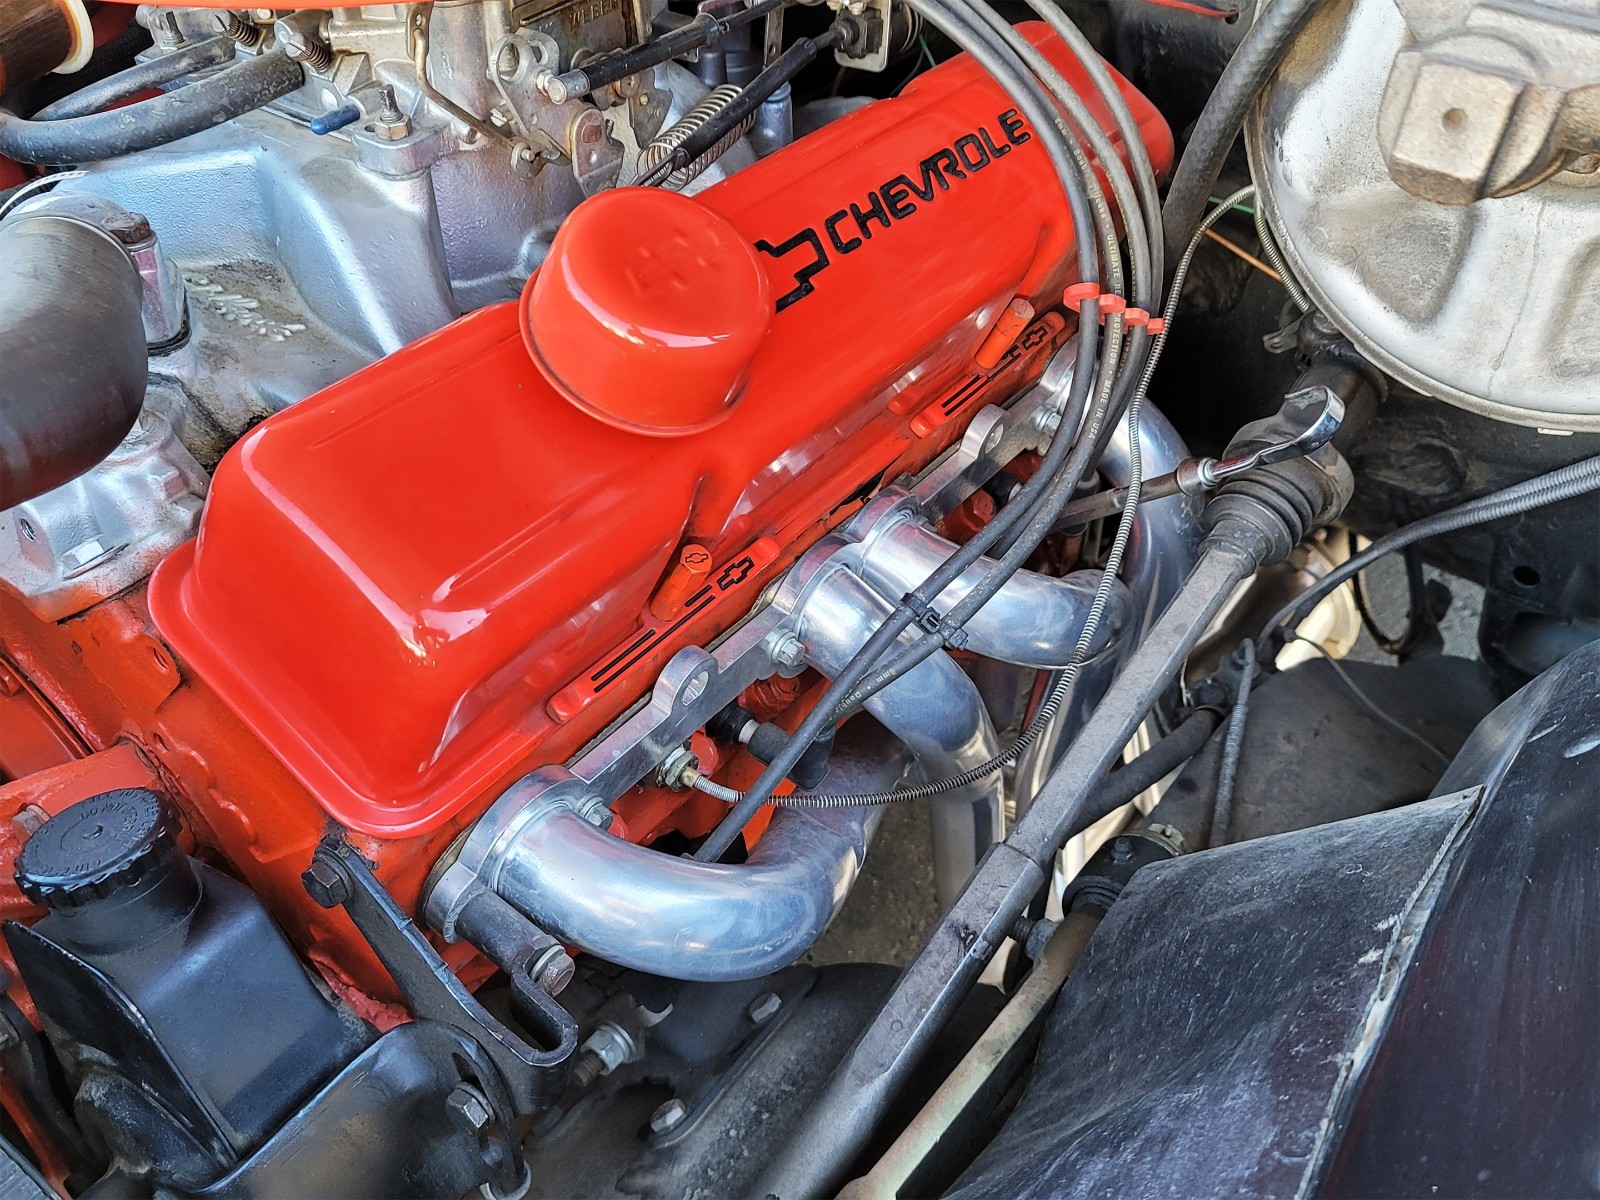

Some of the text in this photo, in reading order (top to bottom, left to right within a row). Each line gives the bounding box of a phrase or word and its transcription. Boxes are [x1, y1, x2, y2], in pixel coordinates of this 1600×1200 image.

[824, 108, 1032, 255] CHEVROLE
[1106, 234, 1120, 278] ULTIMATE
[1100, 380, 1112, 404] MADE
[1095, 408, 1104, 419] IN
[1088, 422, 1100, 439] USA
